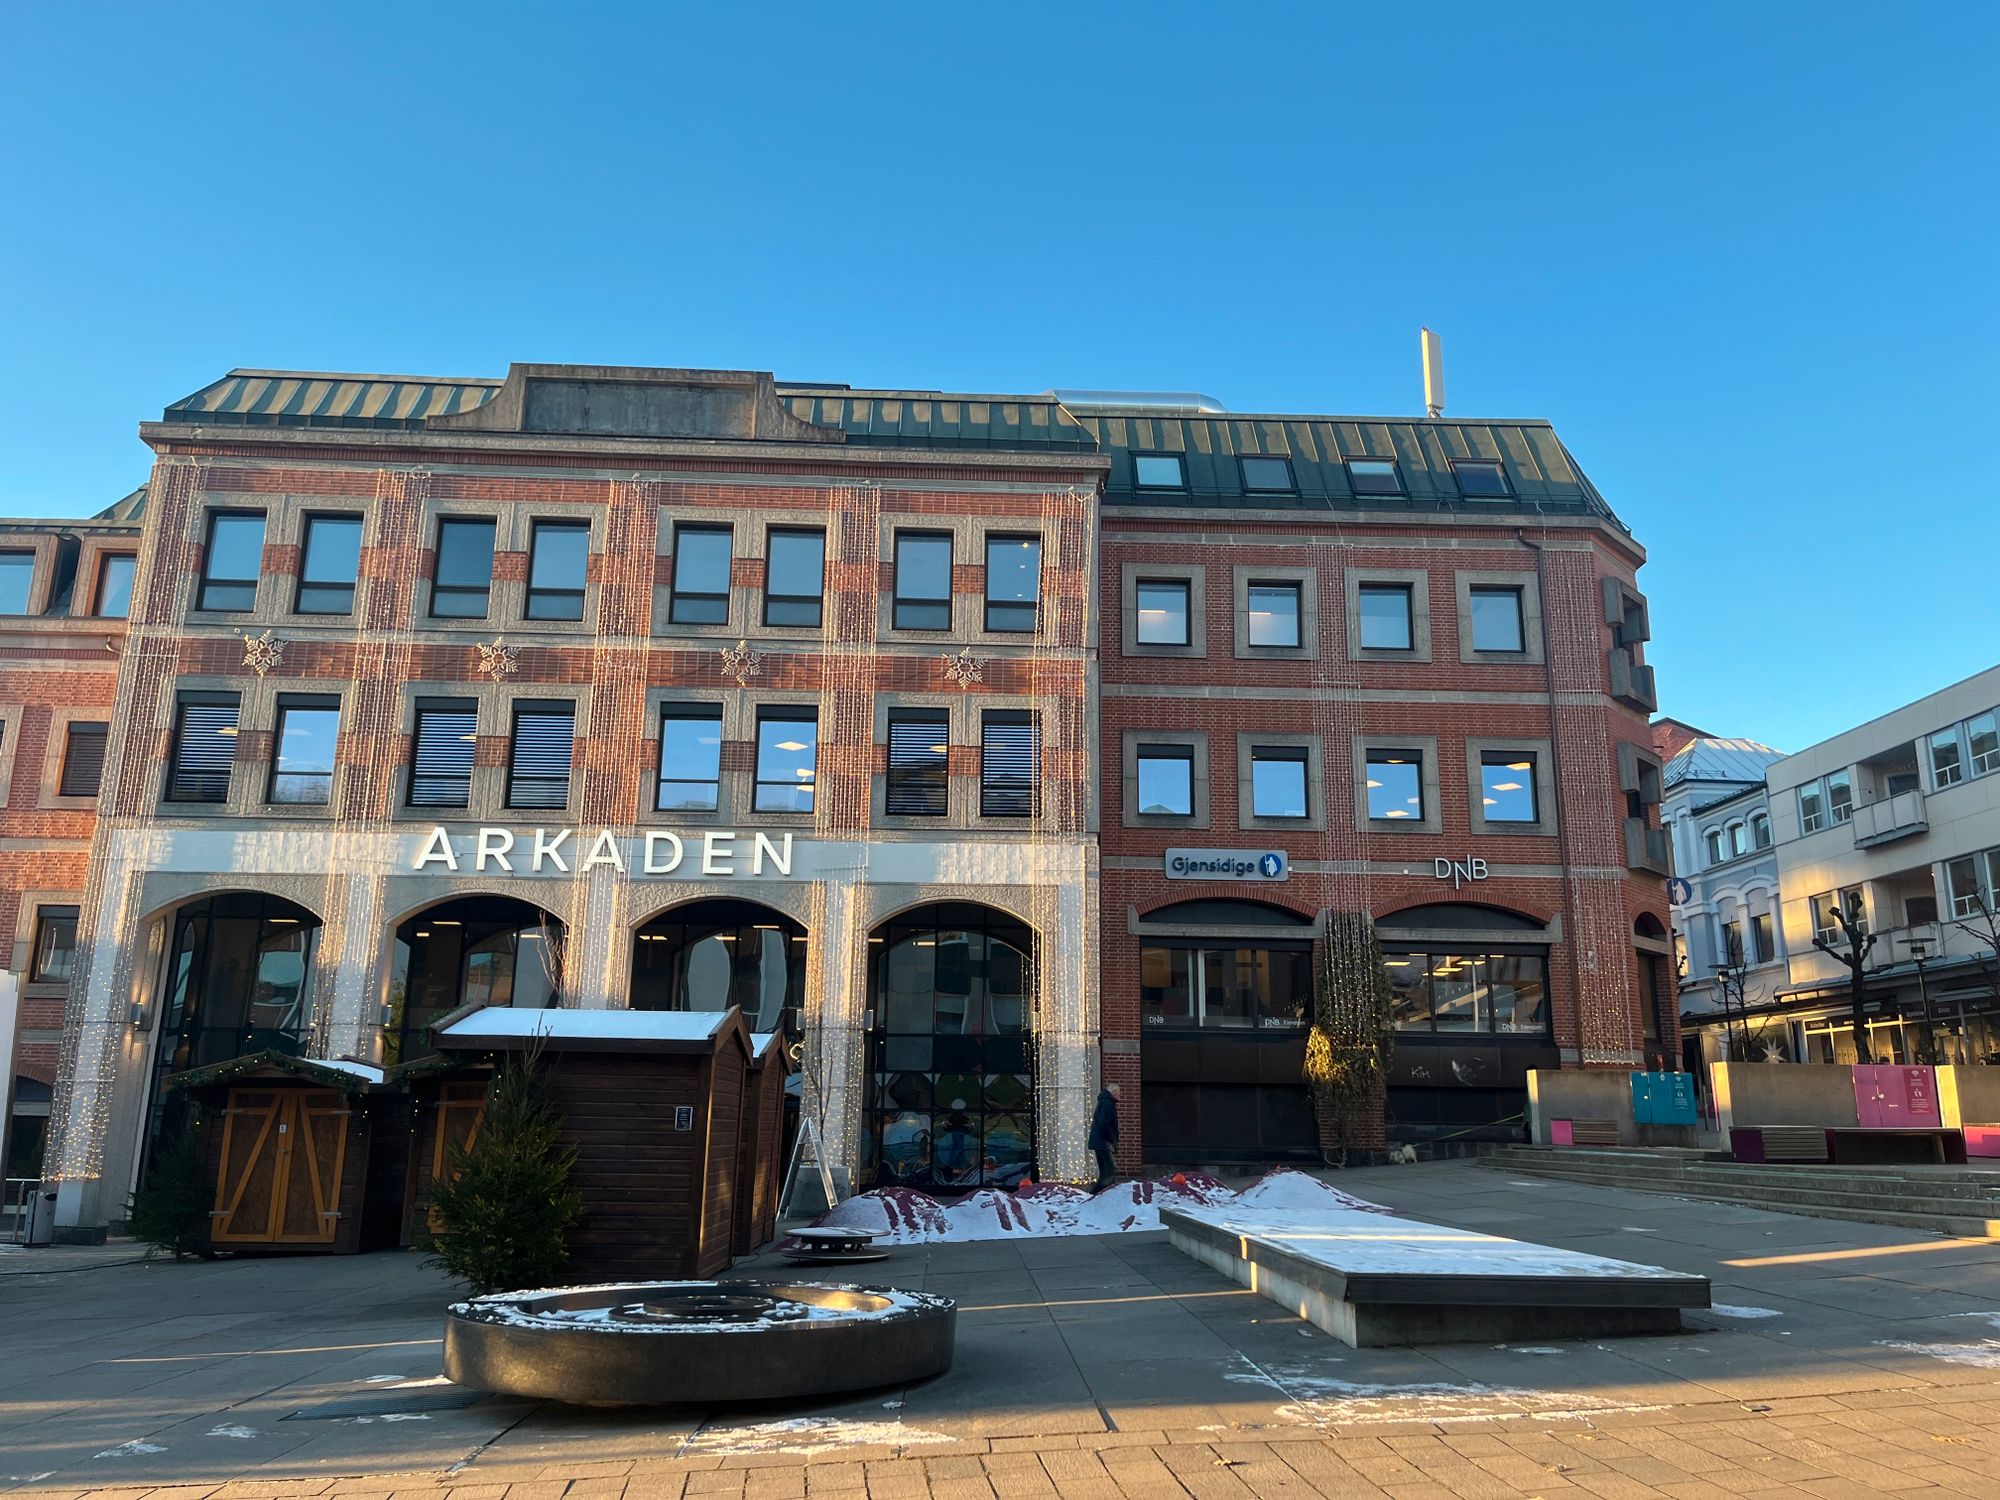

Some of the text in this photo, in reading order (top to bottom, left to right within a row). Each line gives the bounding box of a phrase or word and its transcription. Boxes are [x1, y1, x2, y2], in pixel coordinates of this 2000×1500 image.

[413, 826, 793, 876] ARKADEN
[1172, 856, 1255, 876] Gjensidige
[1434, 853, 1489, 890] DNB
[1149, 1014, 1165, 1025] DNB
[1264, 1016, 1280, 1027] DNB
[1501, 1022, 1517, 1033] DNB
